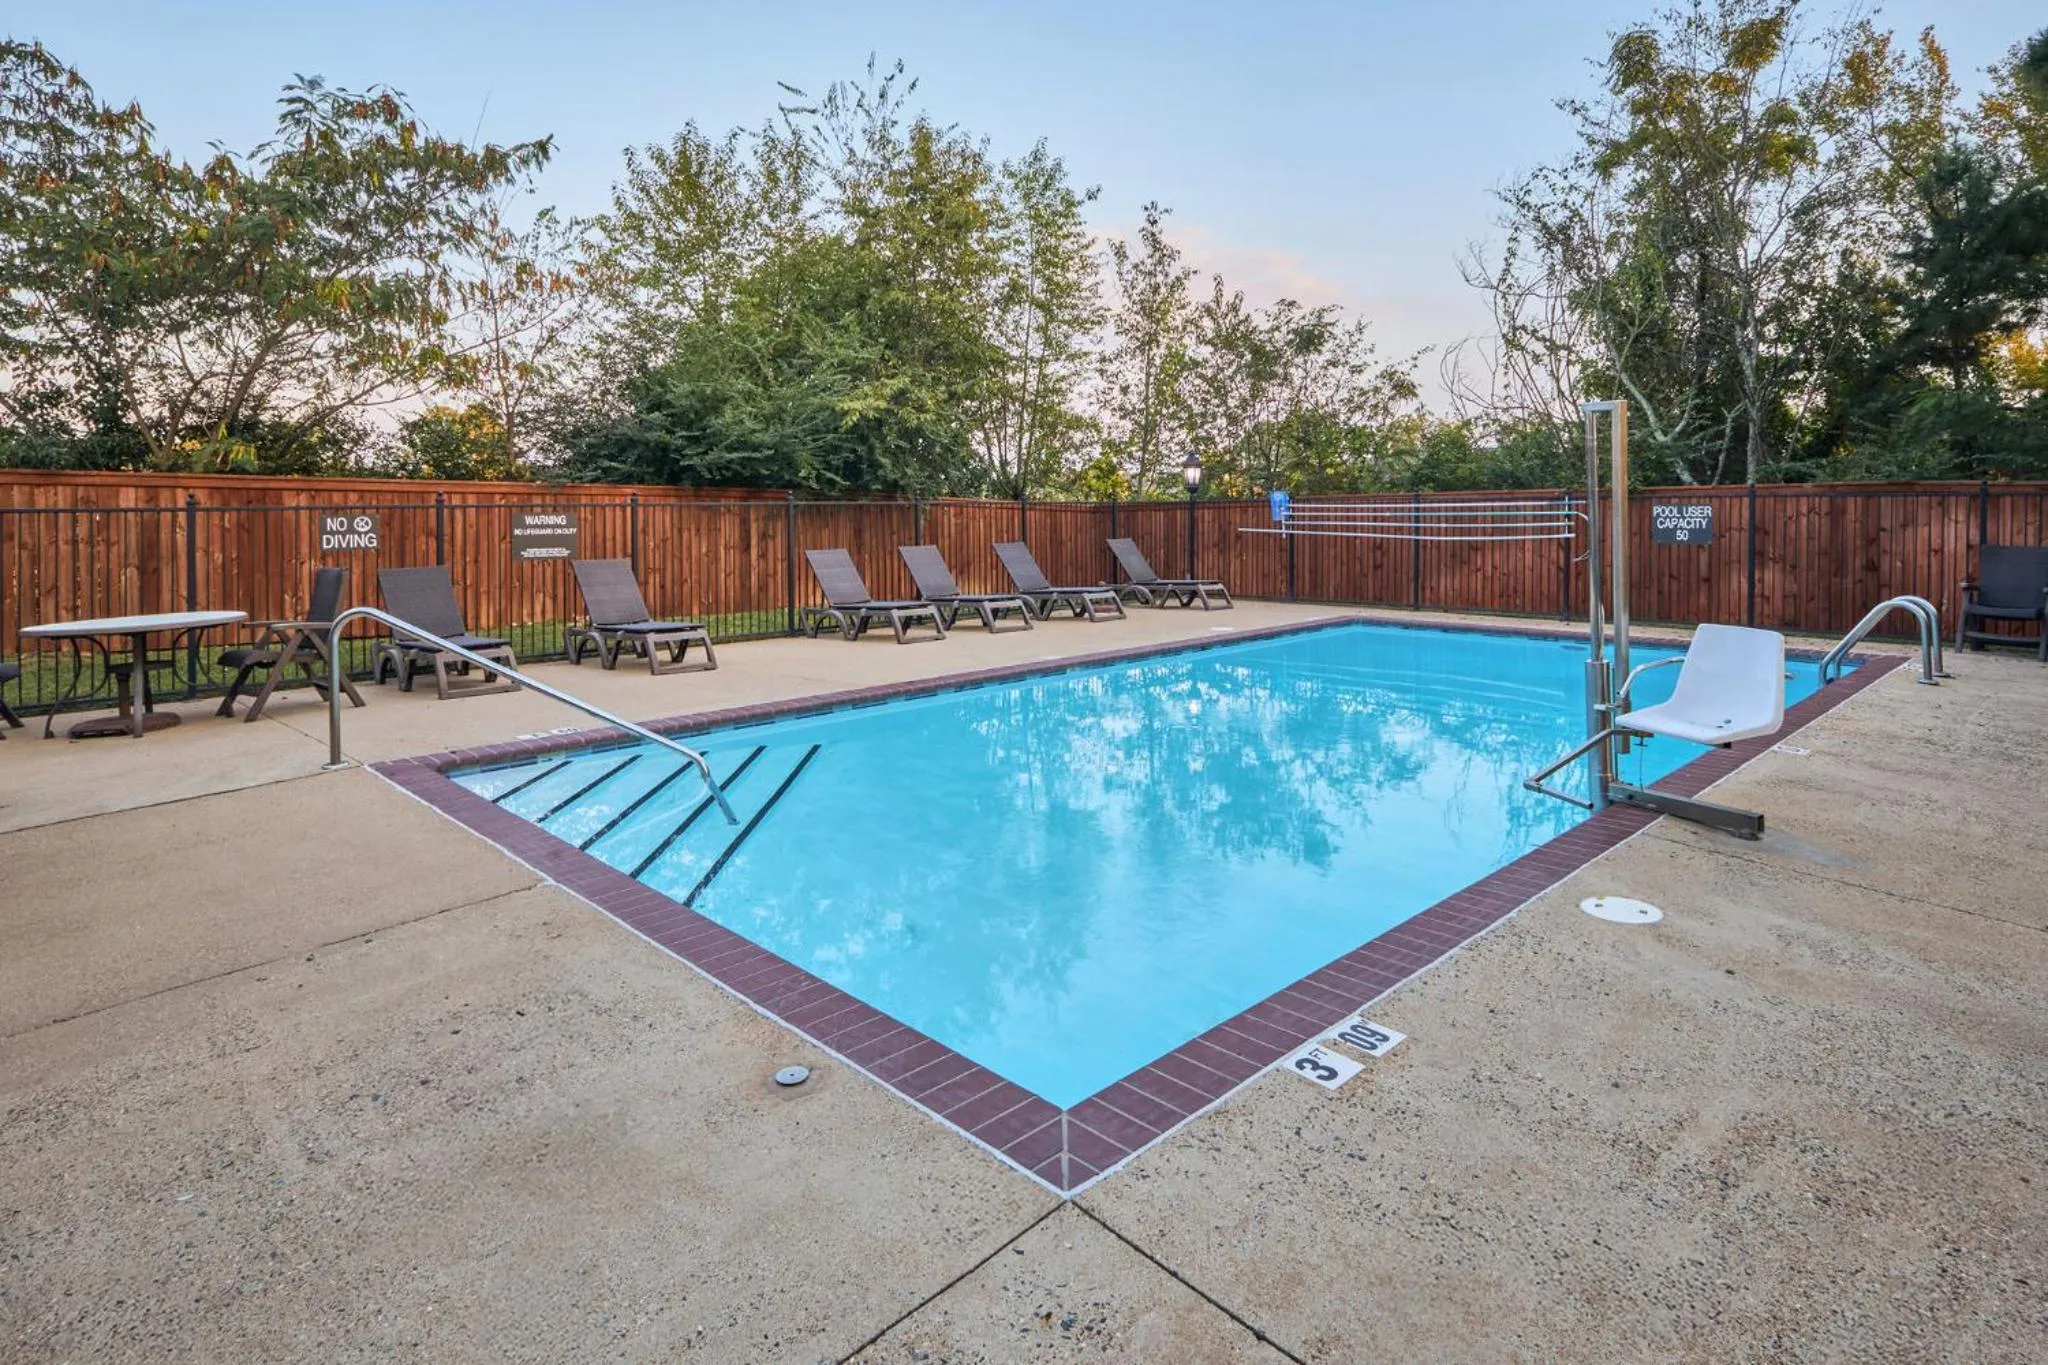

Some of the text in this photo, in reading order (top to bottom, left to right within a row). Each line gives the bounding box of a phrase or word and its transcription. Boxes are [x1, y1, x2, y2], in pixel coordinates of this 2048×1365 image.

[1653, 505, 1712, 517] POOL USER
[327, 516, 348, 531] NO
[524, 514, 567, 525] WARNING
[1656, 517, 1708, 529] CAPACITY
[322, 533, 378, 549] DIVING
[1676, 529, 1689, 541] 50
[1295, 1047, 1339, 1081] 3 FT
